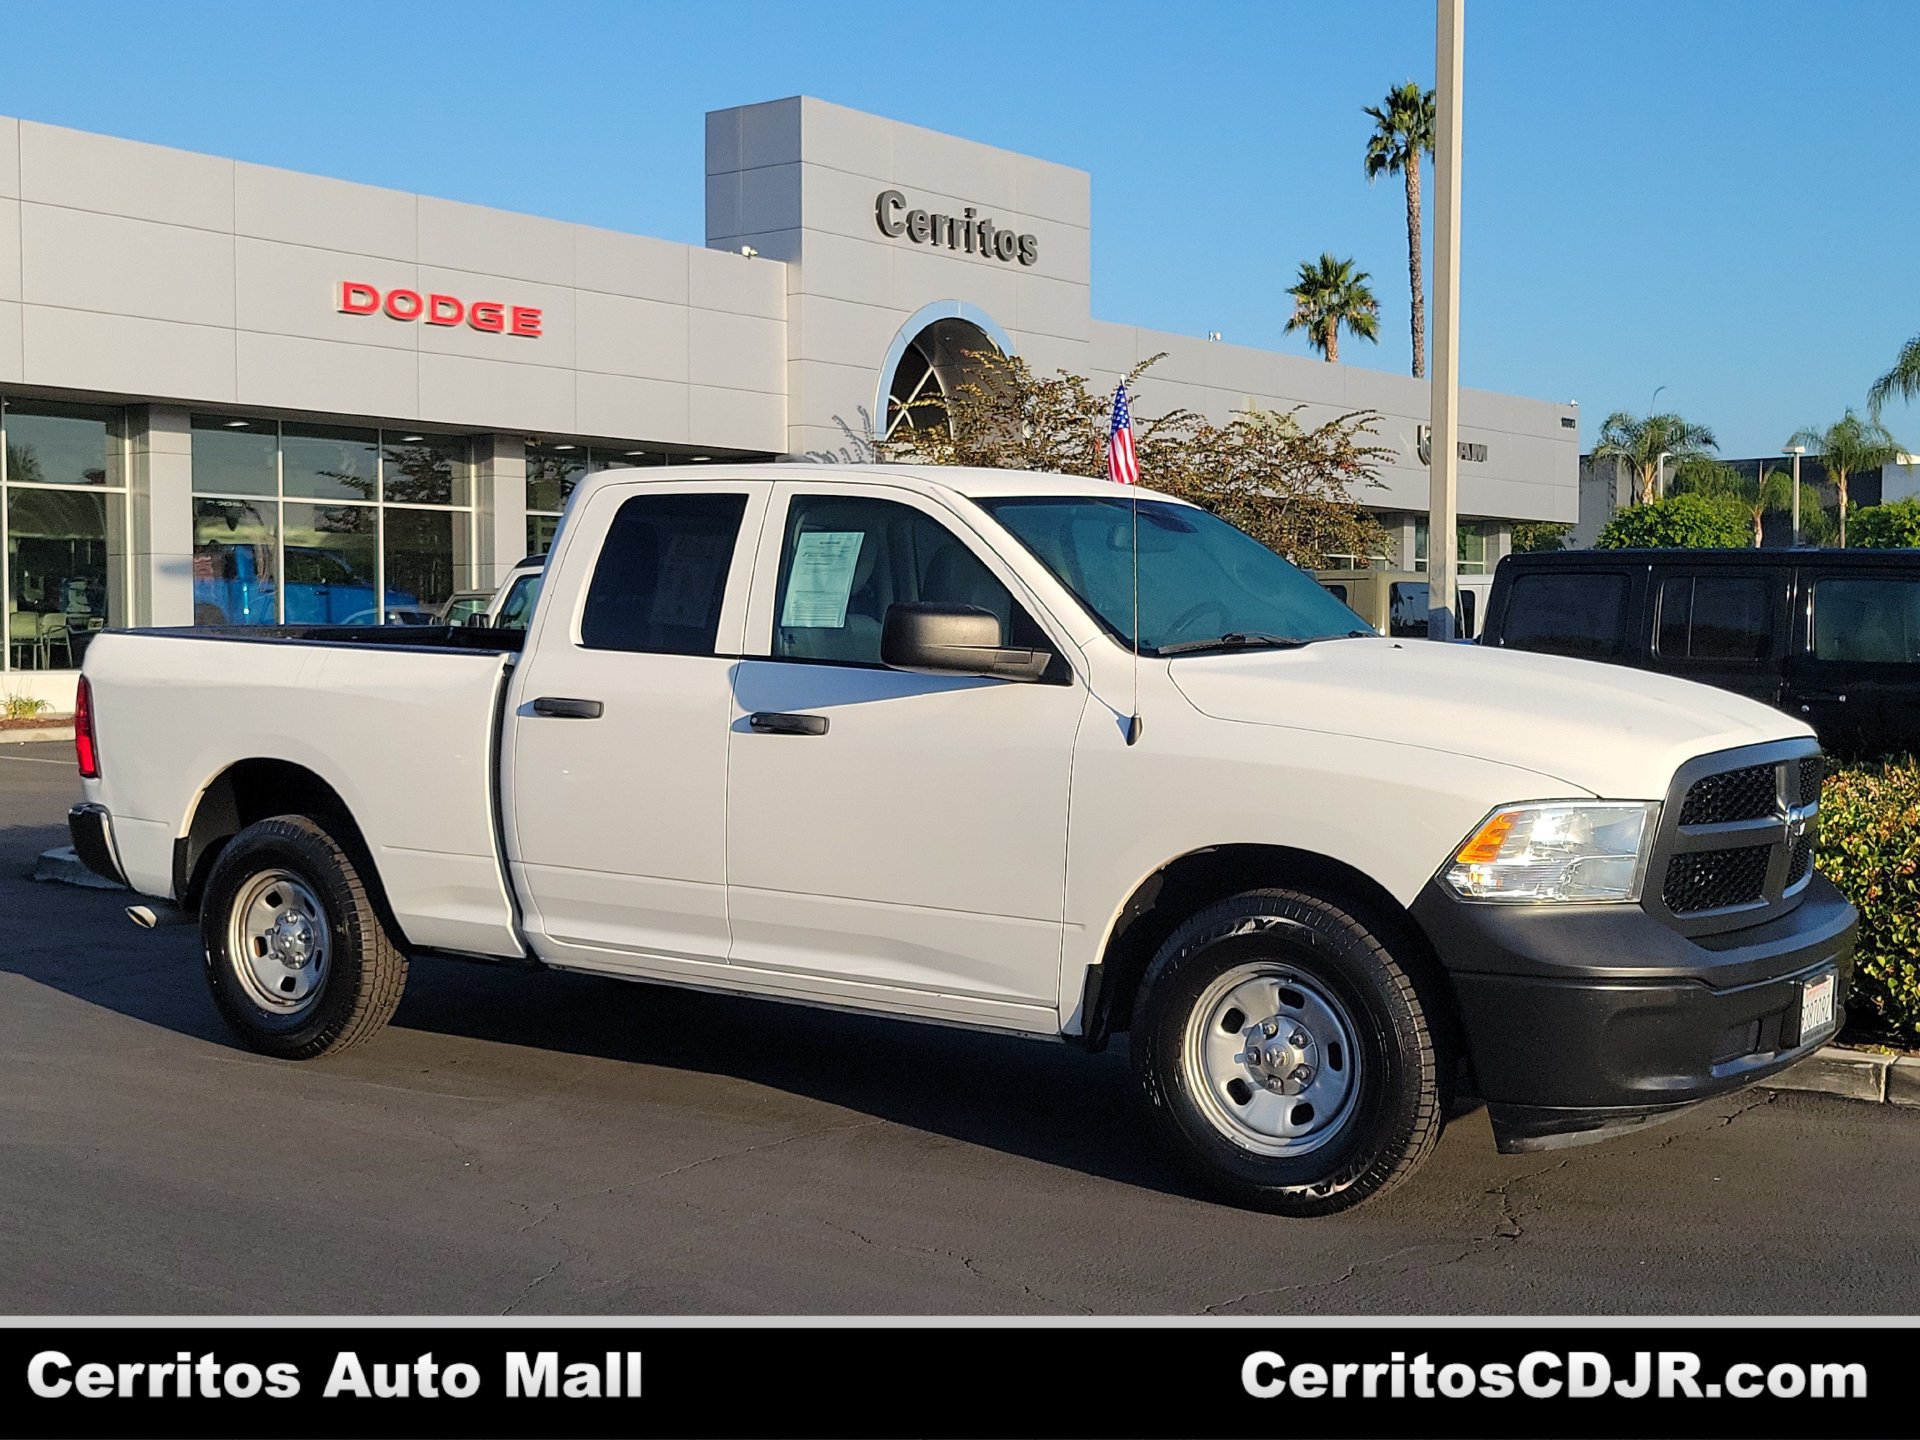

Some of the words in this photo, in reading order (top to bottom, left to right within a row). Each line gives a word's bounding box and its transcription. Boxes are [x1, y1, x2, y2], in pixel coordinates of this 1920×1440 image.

[875, 190, 1039, 266] Cerritos
[338, 281, 543, 338] DODGE
[1457, 441, 1488, 462] AM
